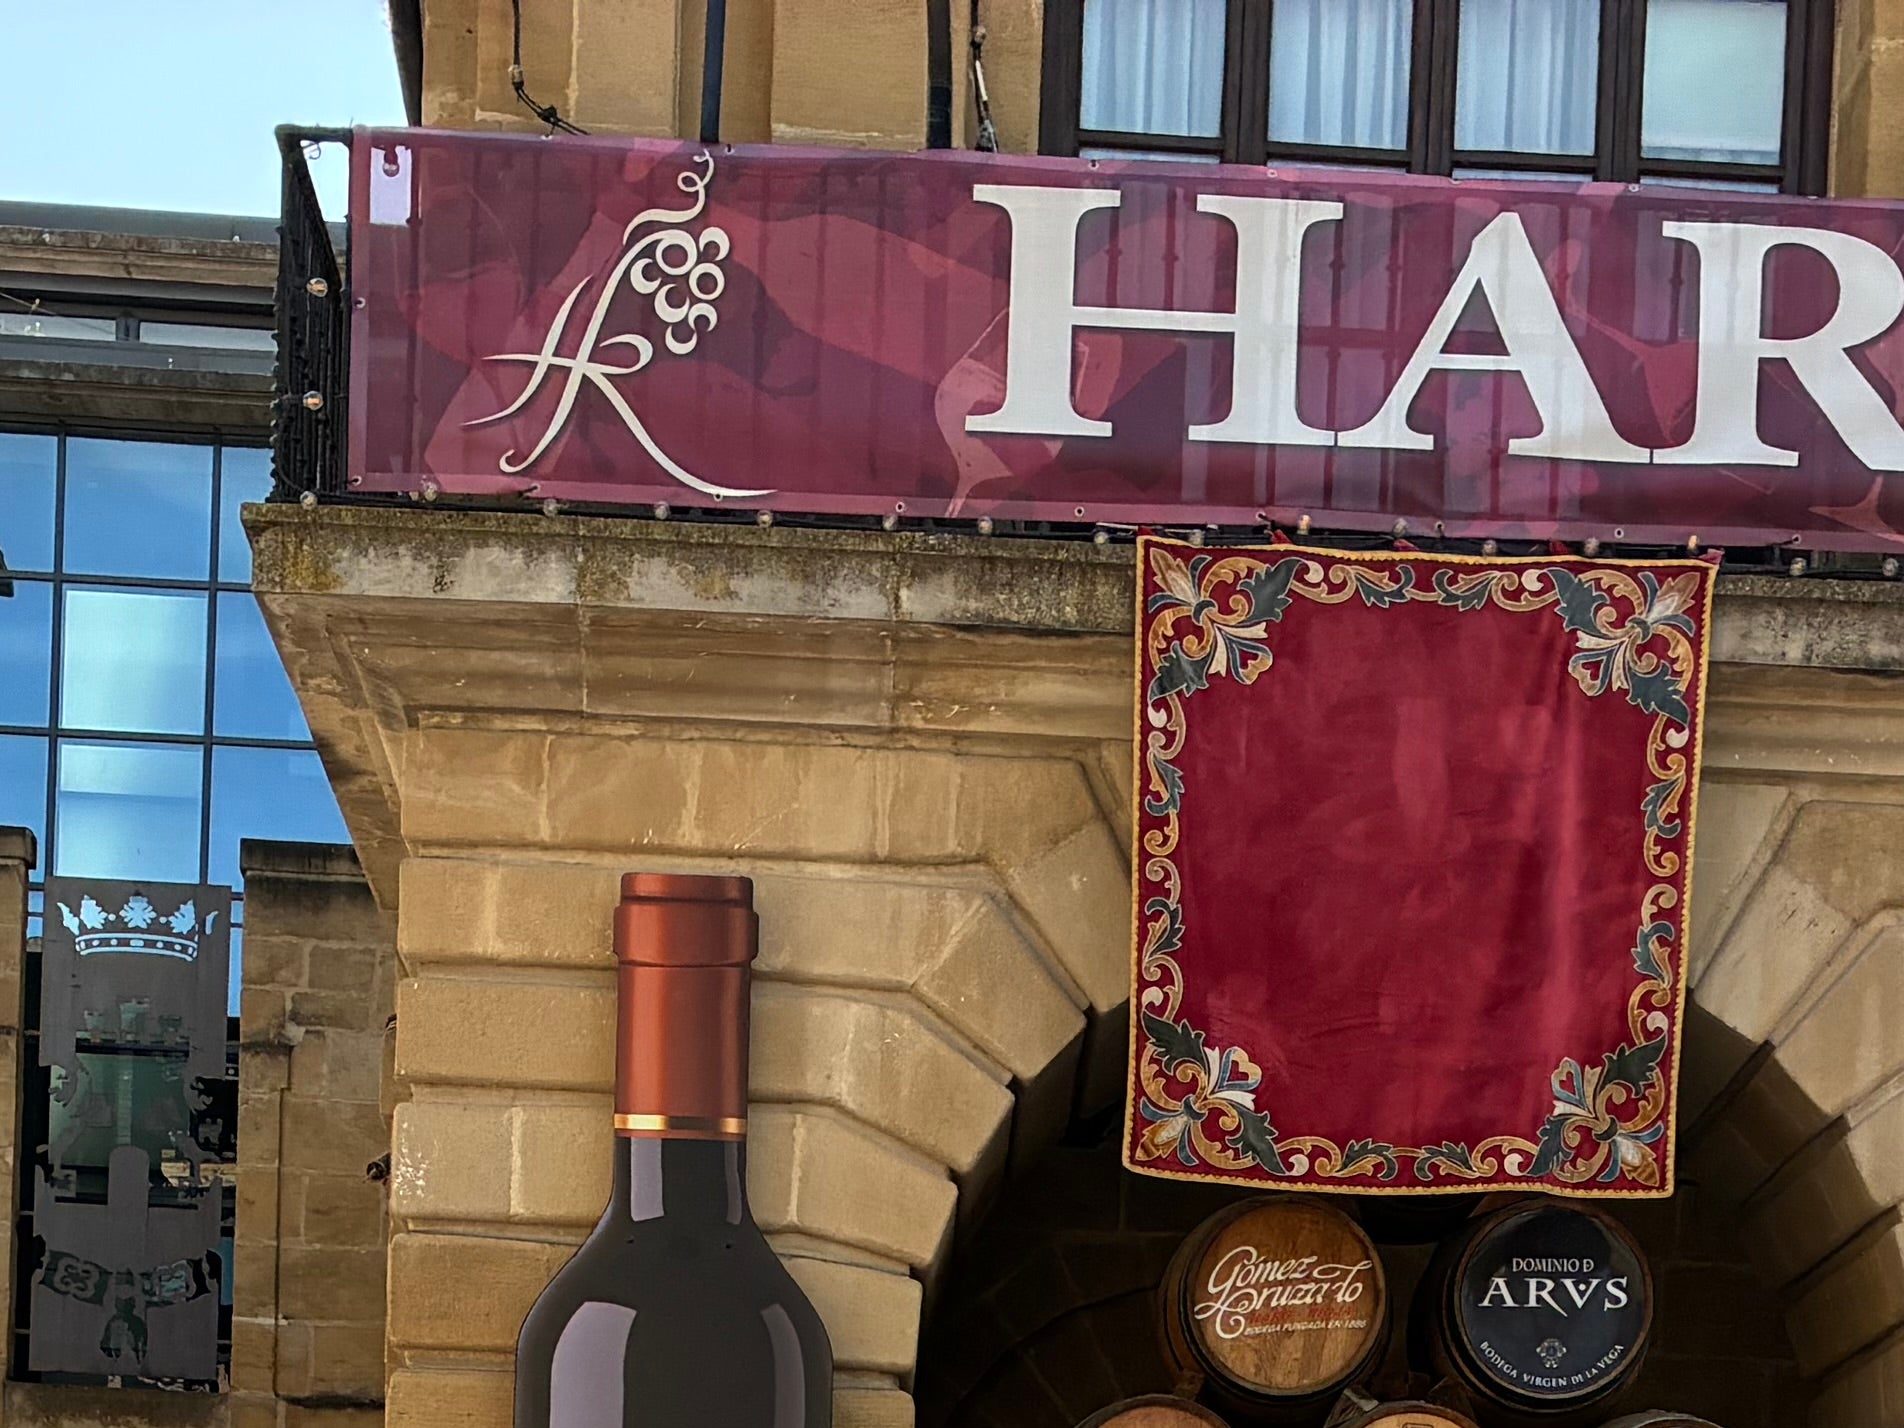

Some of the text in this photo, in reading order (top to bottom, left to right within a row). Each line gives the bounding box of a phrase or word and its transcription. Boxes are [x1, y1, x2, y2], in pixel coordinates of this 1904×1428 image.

[1207, 1246, 1318, 1296] Gómez
[1512, 1257, 1580, 1273] DOMINIO
[1477, 1276, 1629, 1317] ARVS
[1282, 1322, 1326, 1333] FUNDADA
[1479, 1340, 1518, 1379] BODEGA
[1522, 1372, 1568, 1388] VIRGEN
[1597, 1344, 1625, 1370] VEGA
